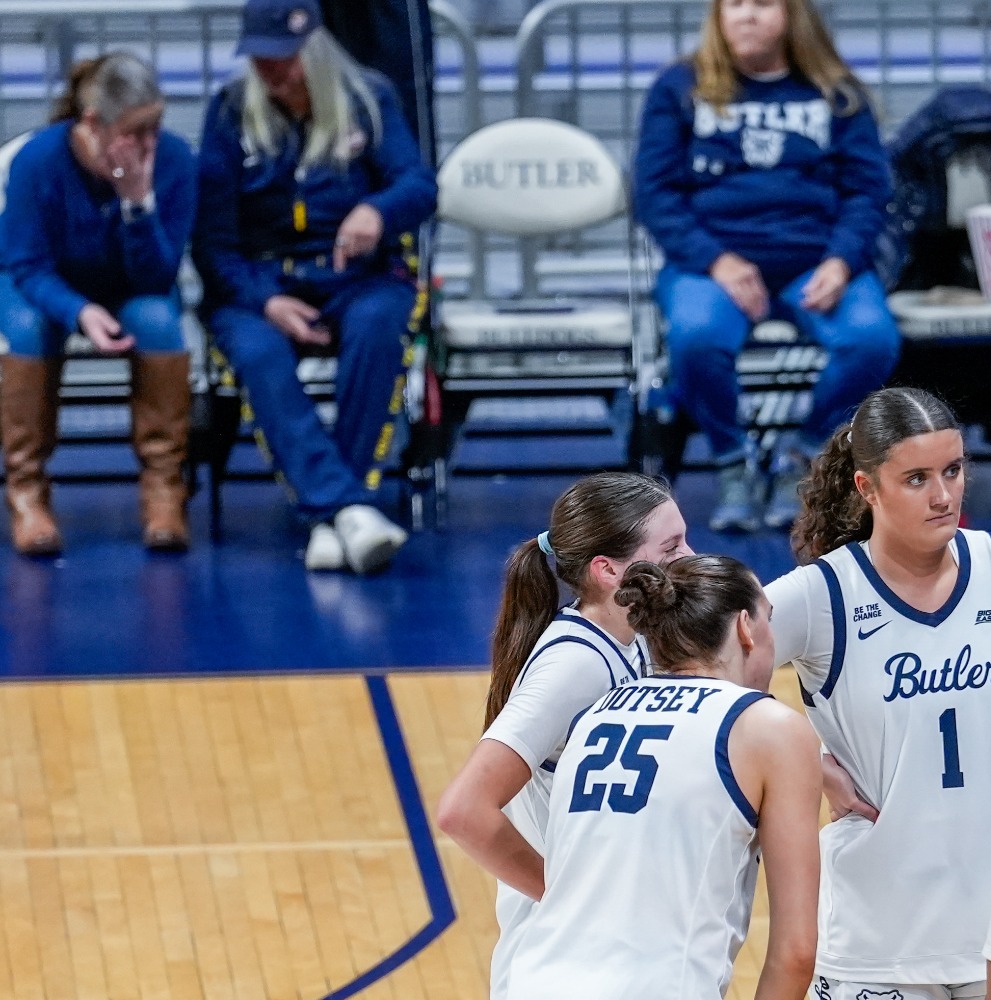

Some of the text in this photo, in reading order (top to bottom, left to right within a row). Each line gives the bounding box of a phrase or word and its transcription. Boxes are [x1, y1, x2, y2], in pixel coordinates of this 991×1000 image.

[459, 160, 601, 189] BUTLER
[853, 609, 882, 622] CHANGE
[854, 602, 879, 615] BE THE
[593, 685, 722, 714] DOTSEY
[939, 708, 964, 788] 1
[568, 722, 675, 814] 25
